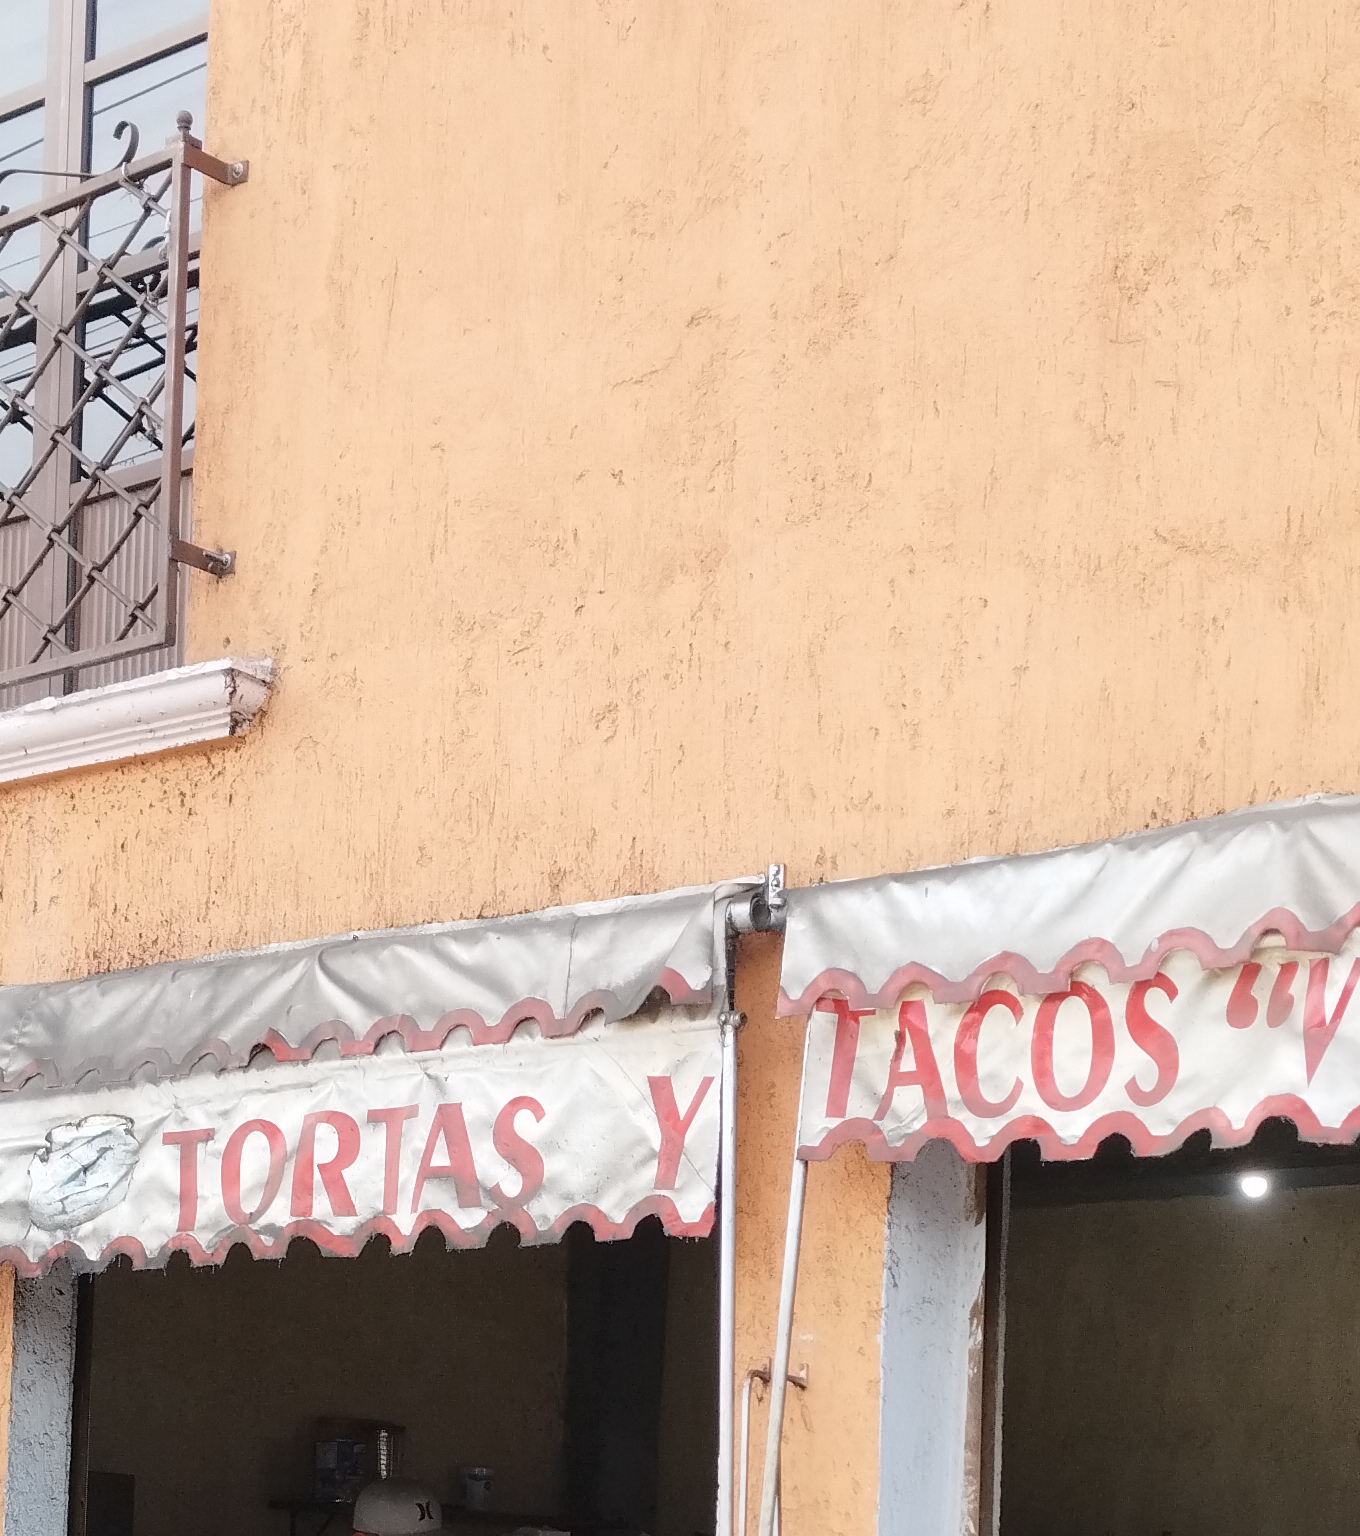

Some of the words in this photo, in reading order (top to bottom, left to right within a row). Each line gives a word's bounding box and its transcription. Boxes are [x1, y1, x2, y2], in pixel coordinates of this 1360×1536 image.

[162, 1096, 547, 1233] TORTAS
[646, 1075, 716, 1192] Y
[815, 971, 1180, 1121] TACOS
